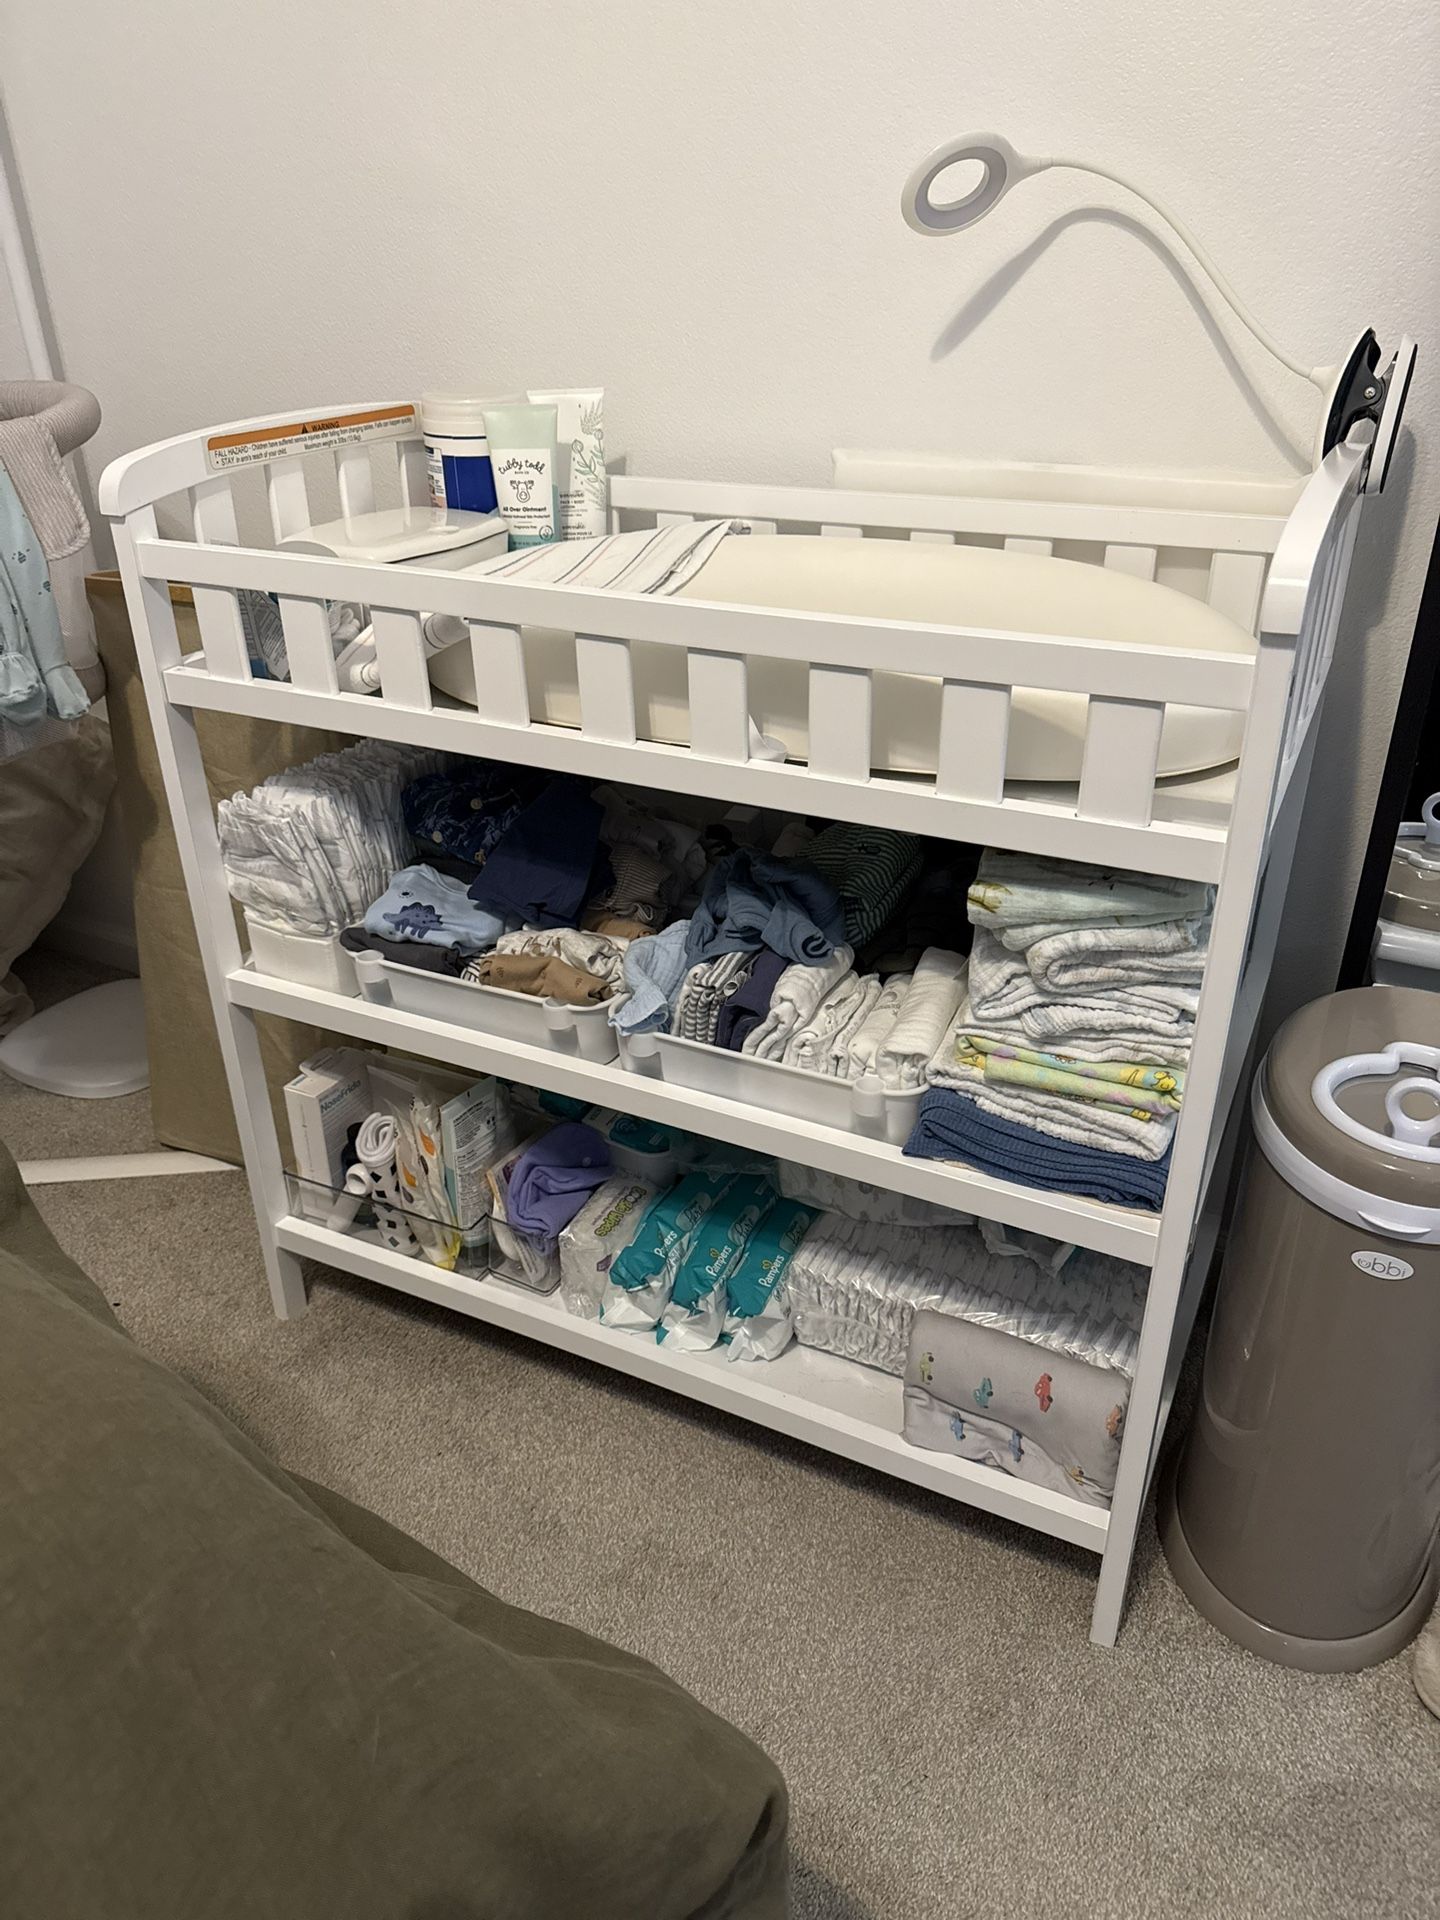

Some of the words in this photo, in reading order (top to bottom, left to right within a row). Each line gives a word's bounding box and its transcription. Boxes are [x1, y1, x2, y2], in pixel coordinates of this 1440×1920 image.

[311, 421, 340, 432] WARNING
[214, 450, 227, 458] FALL
[228, 446, 248, 456] HAZARD
[252, 442, 268, 451] Children
[221, 456, 235, 466] STAY
[498, 458, 523, 475] tubby
[524, 460, 545, 475] todd
[320, 1080, 360, 1114] NoseFrida
[654, 1231, 678, 1258] Pers
[705, 1245, 732, 1276] Pampers
[1358, 1257, 1406, 1277] ubbi
[758, 1255, 784, 1288] Pampers
